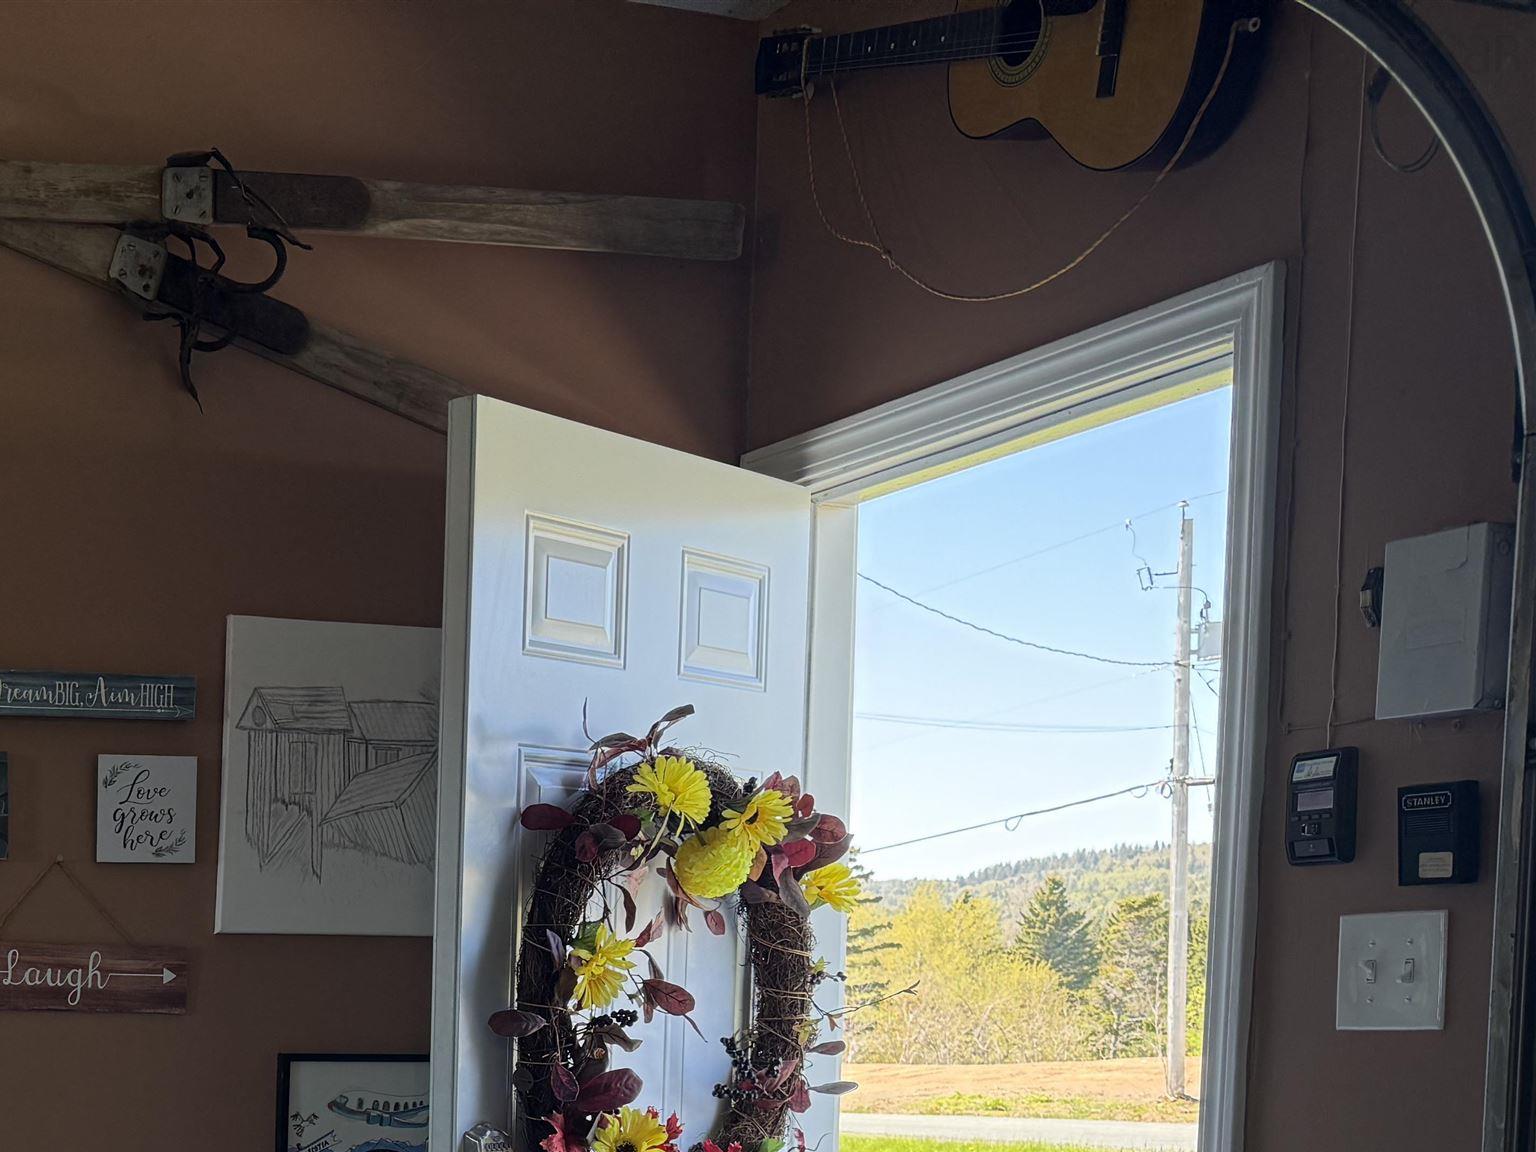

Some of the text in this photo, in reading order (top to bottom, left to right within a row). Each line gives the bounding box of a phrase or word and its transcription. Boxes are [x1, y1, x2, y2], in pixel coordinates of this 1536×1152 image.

[85, 675, 141, 708] Aim
[139, 683, 176, 709] HIGH
[116, 769, 172, 805] Love
[1406, 794, 1446, 808] STANLEY
[112, 806, 177, 834] grows
[123, 824, 174, 851] here
[2, 949, 110, 1006] Laugh
